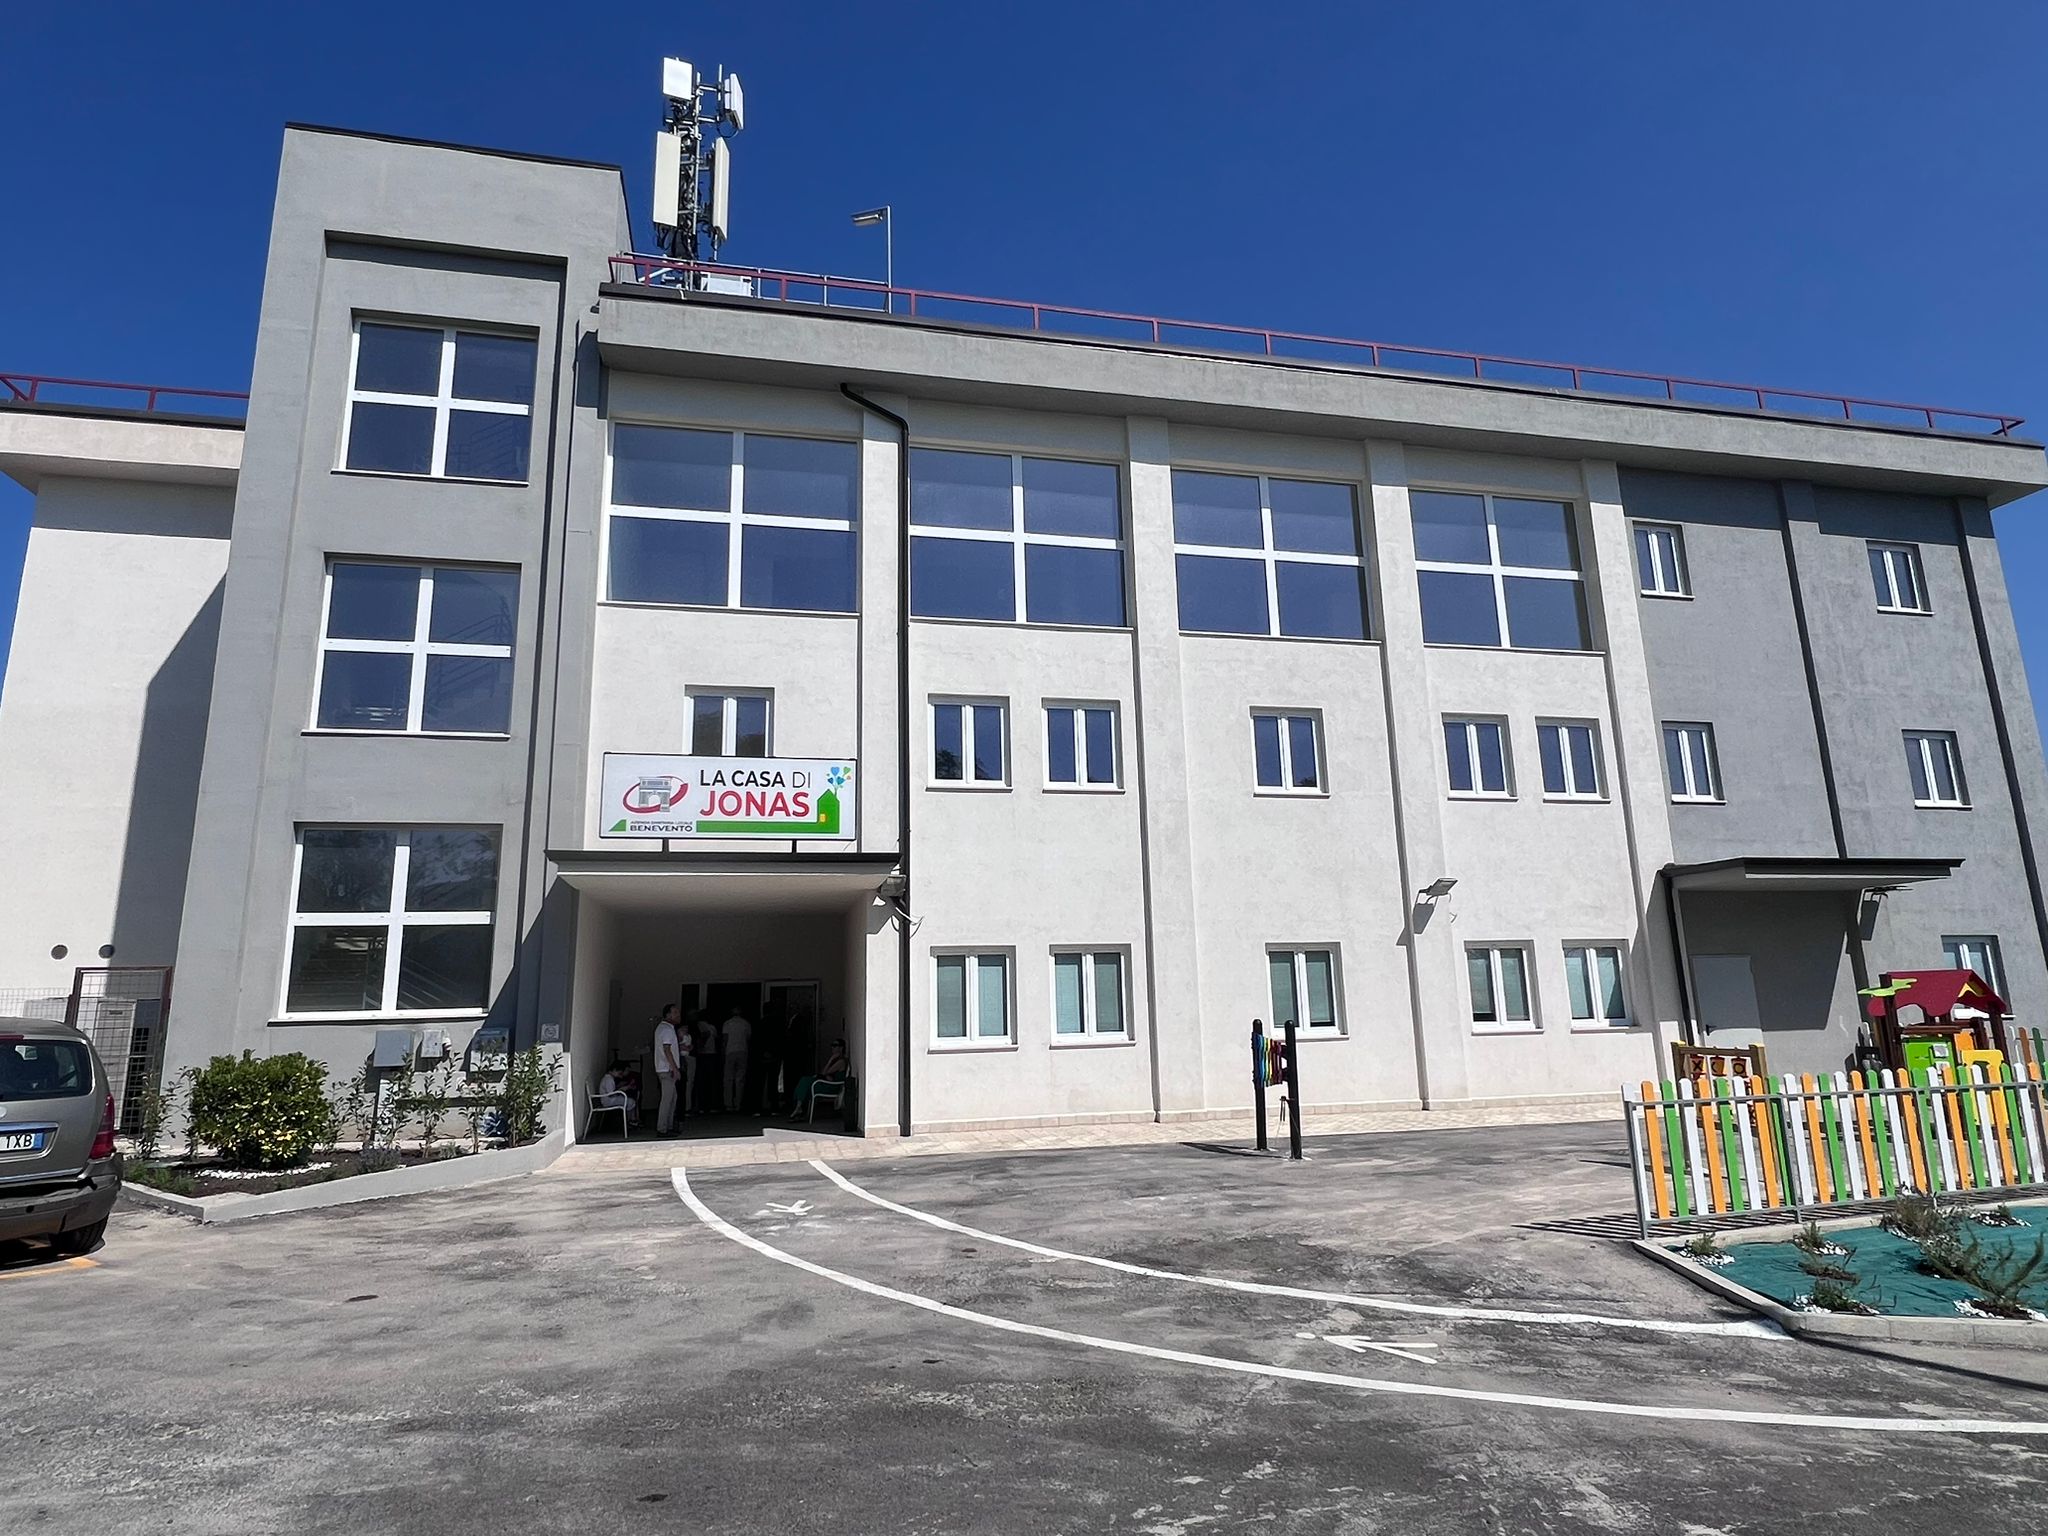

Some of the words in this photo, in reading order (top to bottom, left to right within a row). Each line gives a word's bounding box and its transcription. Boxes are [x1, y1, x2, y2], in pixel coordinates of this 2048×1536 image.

[700, 769, 727, 787] LA
[731, 769, 786, 788] CASA
[792, 771, 811, 789] DI
[699, 790, 810, 818] JONAS
[630, 824, 693, 833] BENEVENTO
